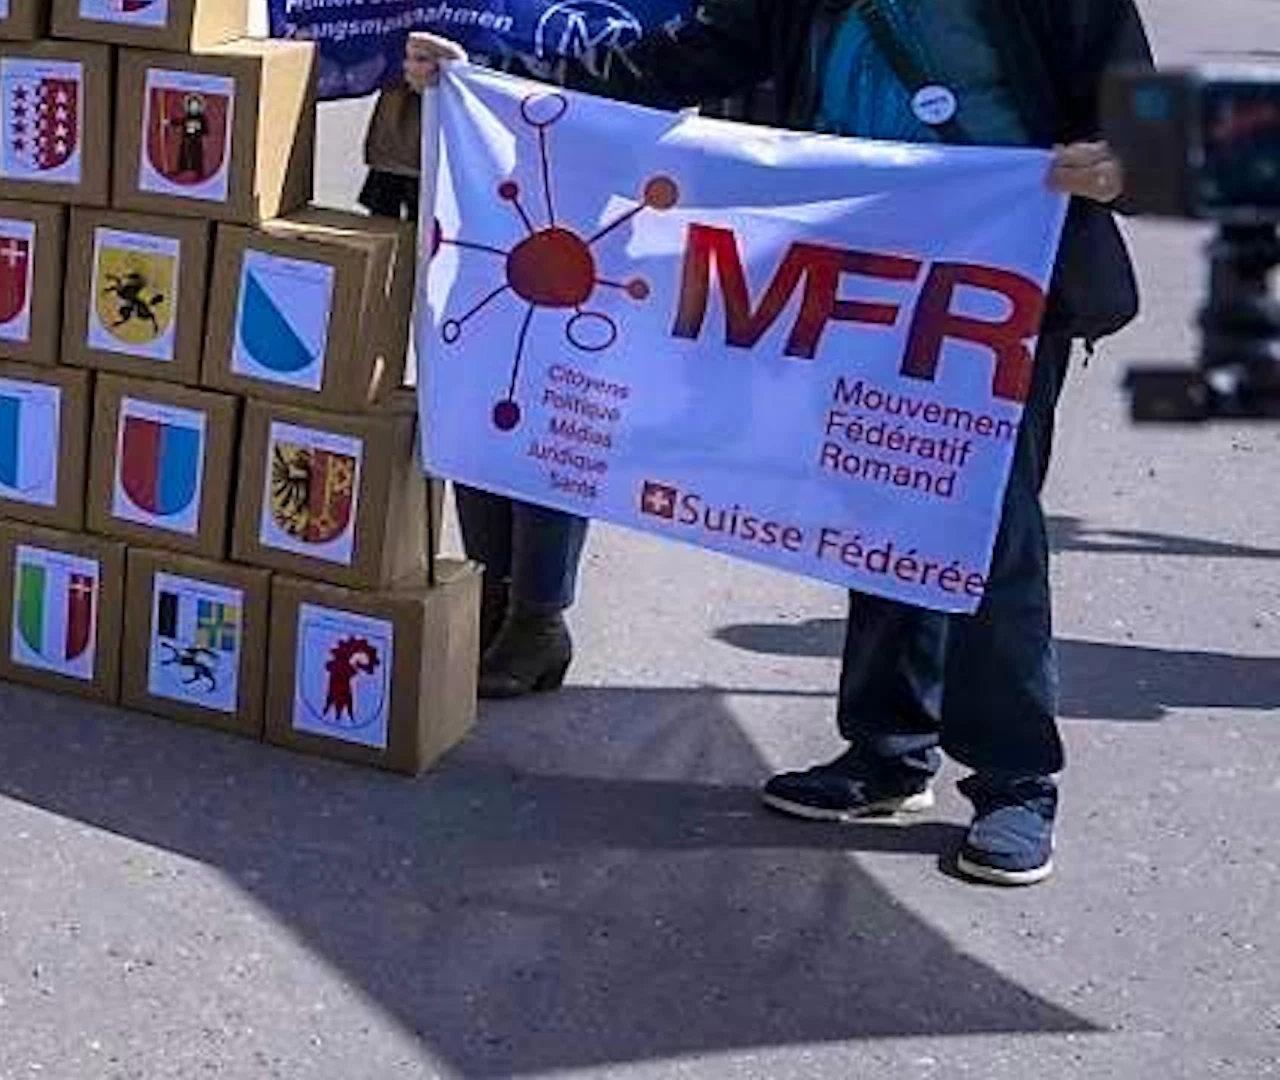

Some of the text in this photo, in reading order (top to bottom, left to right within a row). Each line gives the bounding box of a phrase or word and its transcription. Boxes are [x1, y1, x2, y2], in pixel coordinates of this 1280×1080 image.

[672, 223, 1044, 404] MFR
[820, 442, 957, 498] Romand
[826, 410, 973, 467] Fédératif
[678, 493, 987, 598] Suisse Fédérée
